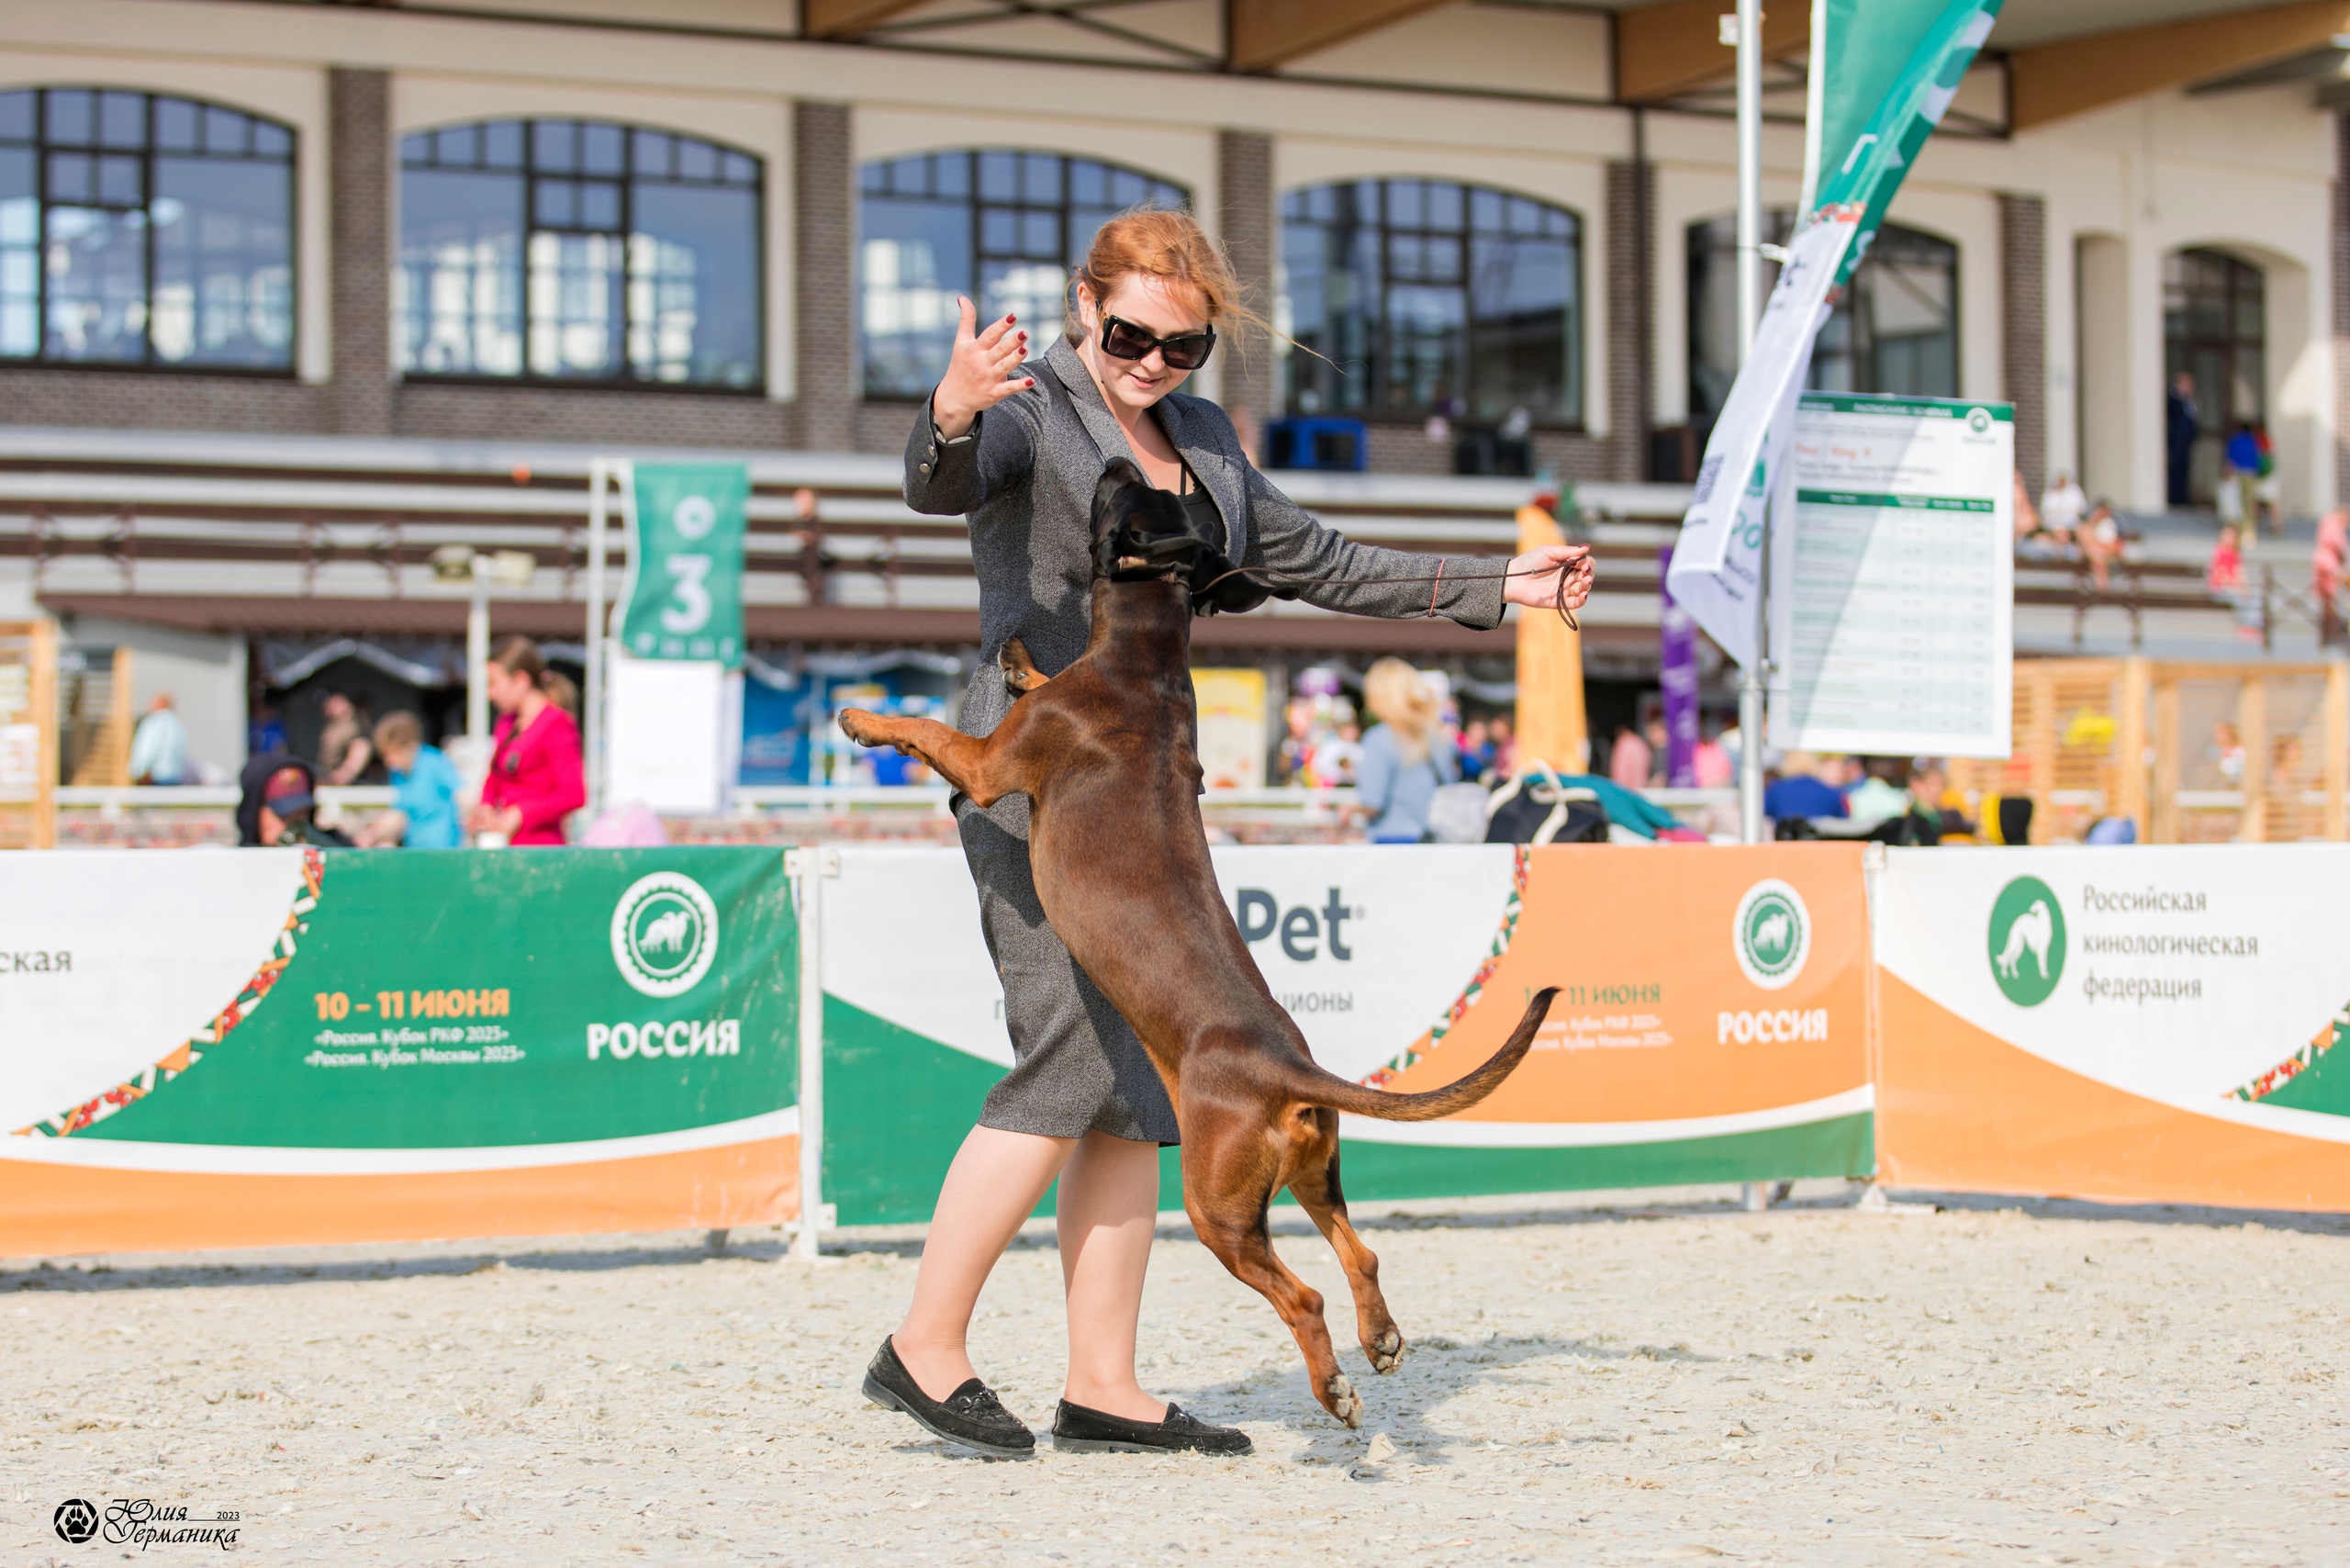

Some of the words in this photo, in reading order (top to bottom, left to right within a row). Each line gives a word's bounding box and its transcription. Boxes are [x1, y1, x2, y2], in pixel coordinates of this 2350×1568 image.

[660, 553, 712, 635] 3
[2083, 884, 2207, 912] Российская
[2083, 935, 2258, 956] кинологическая
[1569, 985, 1585, 1005] 11
[1593, 983, 1661, 1005] ИЮНЯ
[2083, 968, 2202, 1006] федерация
[314, 991, 350, 1022] 10
[376, 991, 405, 1020] 11
[410, 988, 510, 1019] ИЮНЯ
[381, 1026, 428, 1048] Кубок
[587, 1019, 741, 1060] РОССИЯ
[1718, 1008, 1828, 1045] РОССИЯ
[371, 1047, 418, 1070] Кубок
[420, 1047, 480, 1064] Москвы
